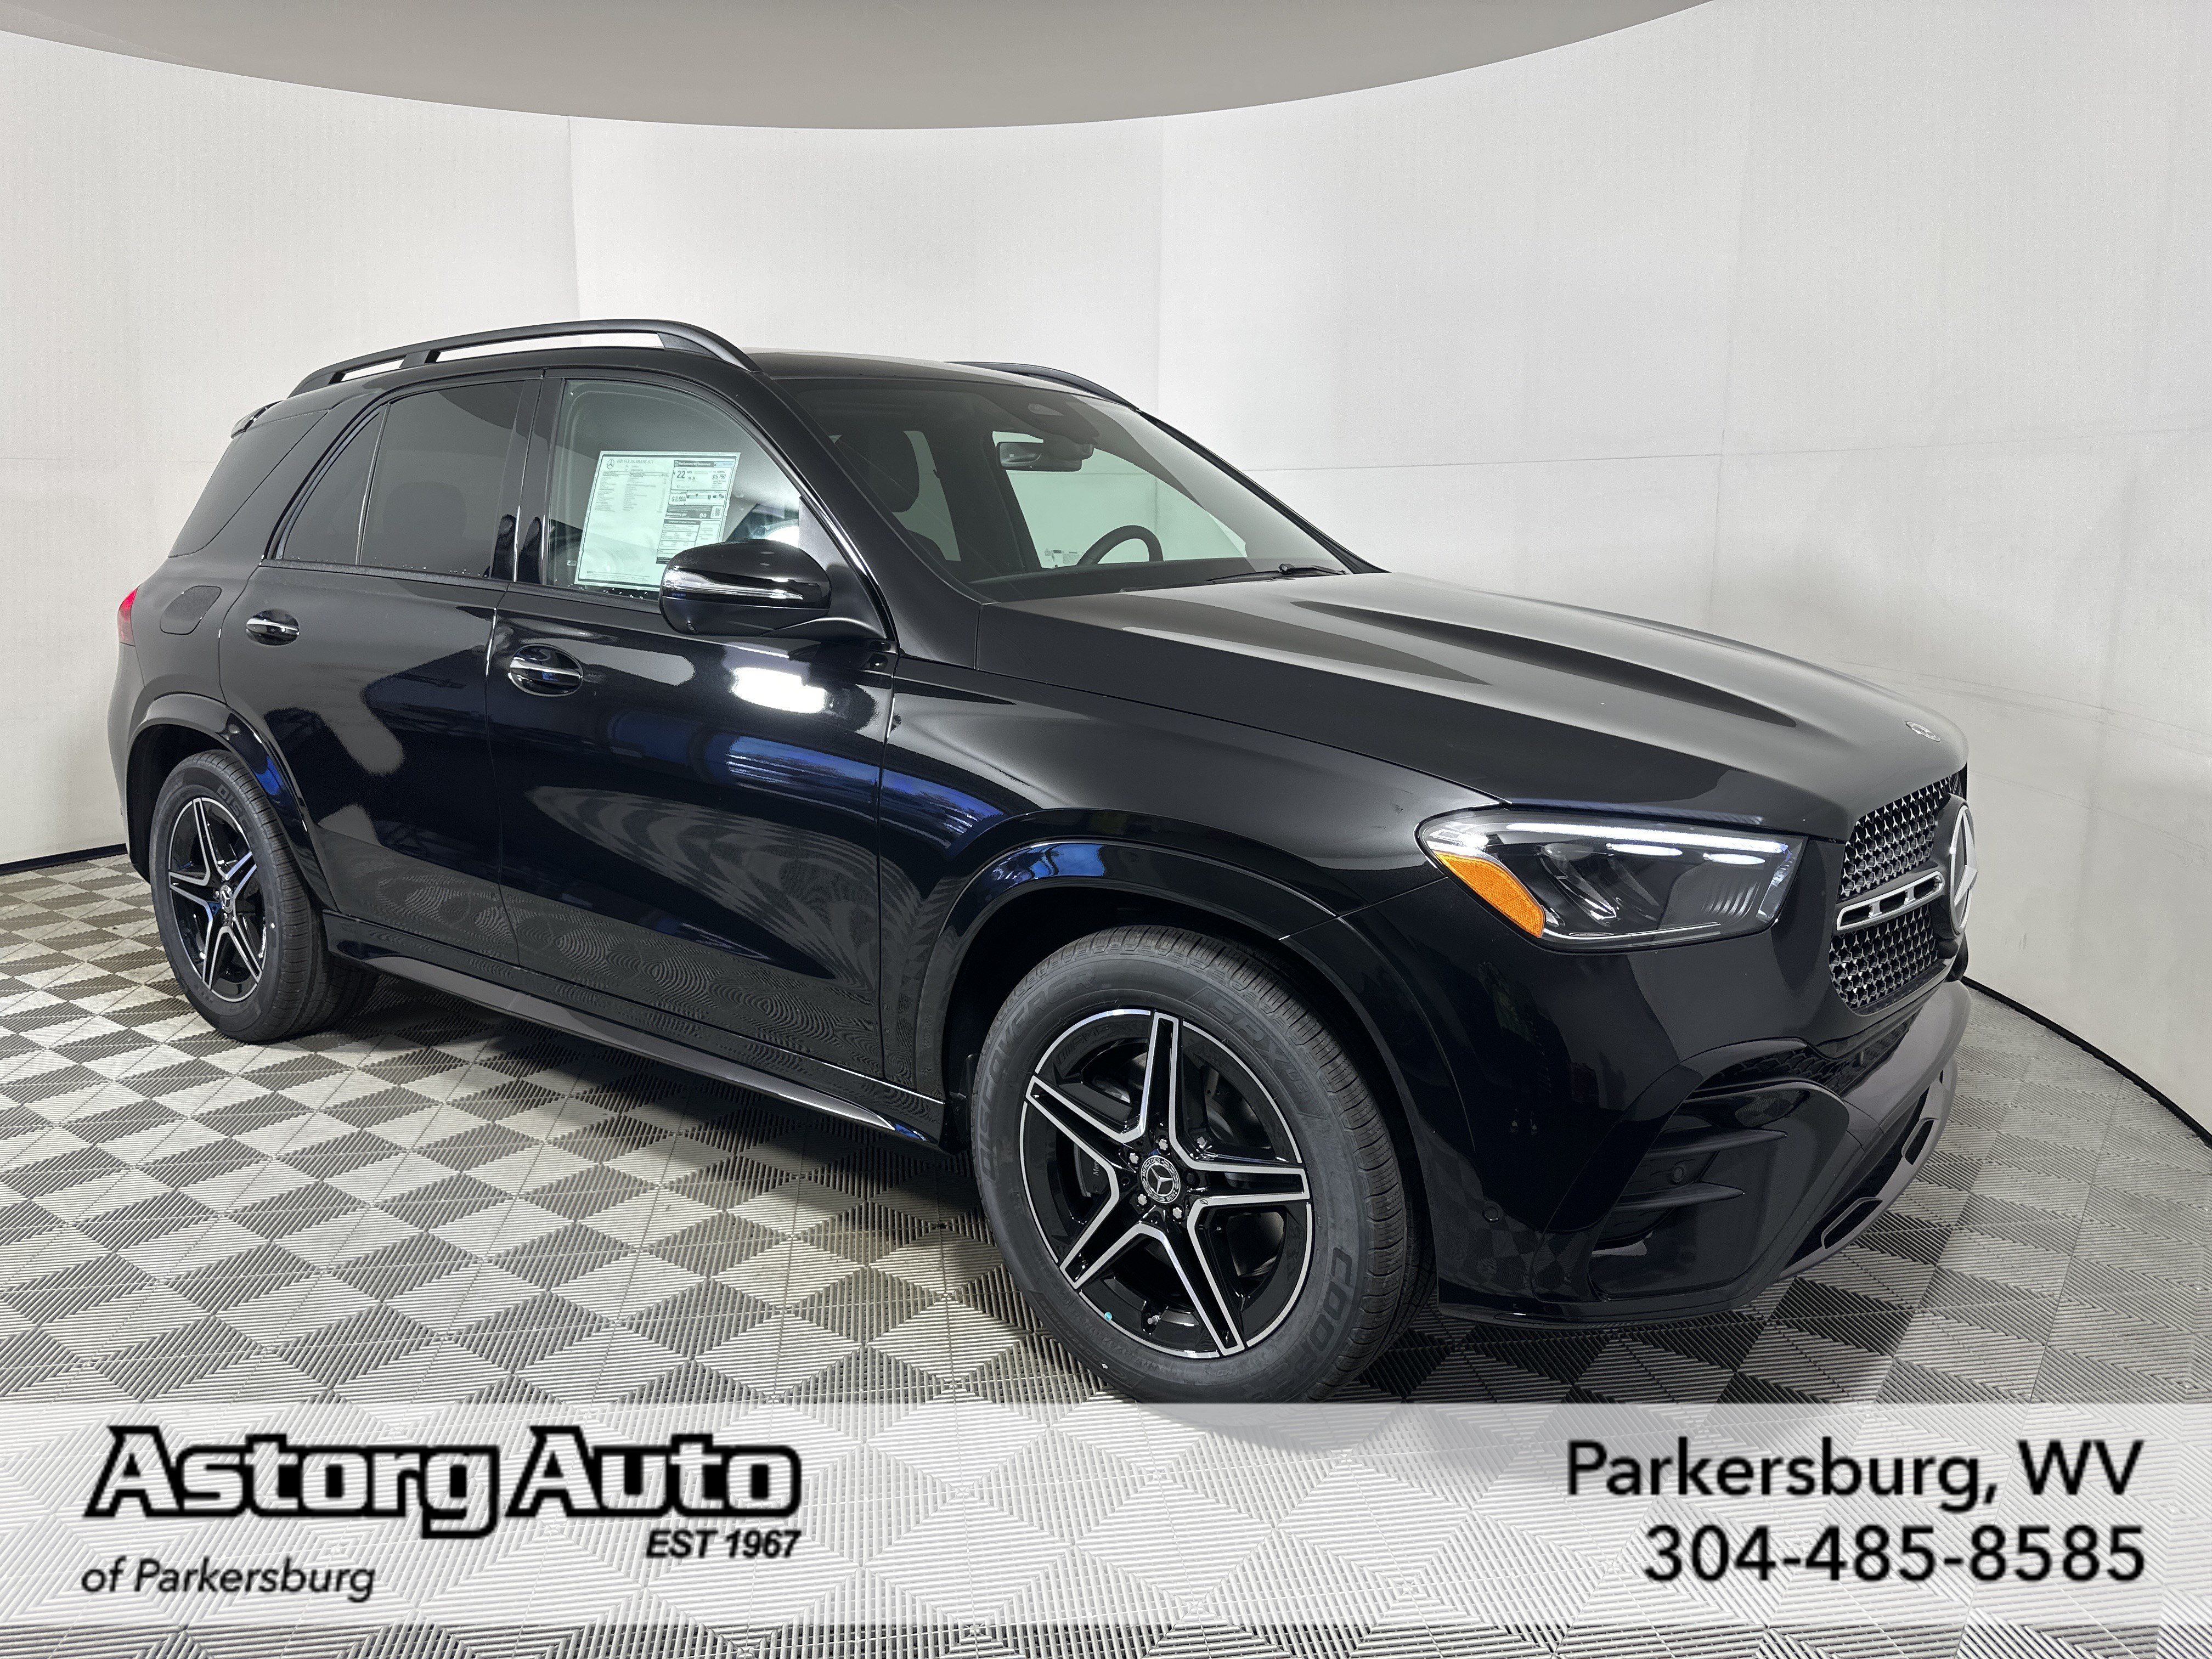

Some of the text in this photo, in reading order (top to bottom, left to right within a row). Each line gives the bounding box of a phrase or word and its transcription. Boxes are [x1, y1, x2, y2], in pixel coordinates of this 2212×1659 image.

[676, 470, 686, 479] 22
[1142, 1158, 1161, 1177] MERCEDES
[1166, 1189, 1178, 1201] BENZ
